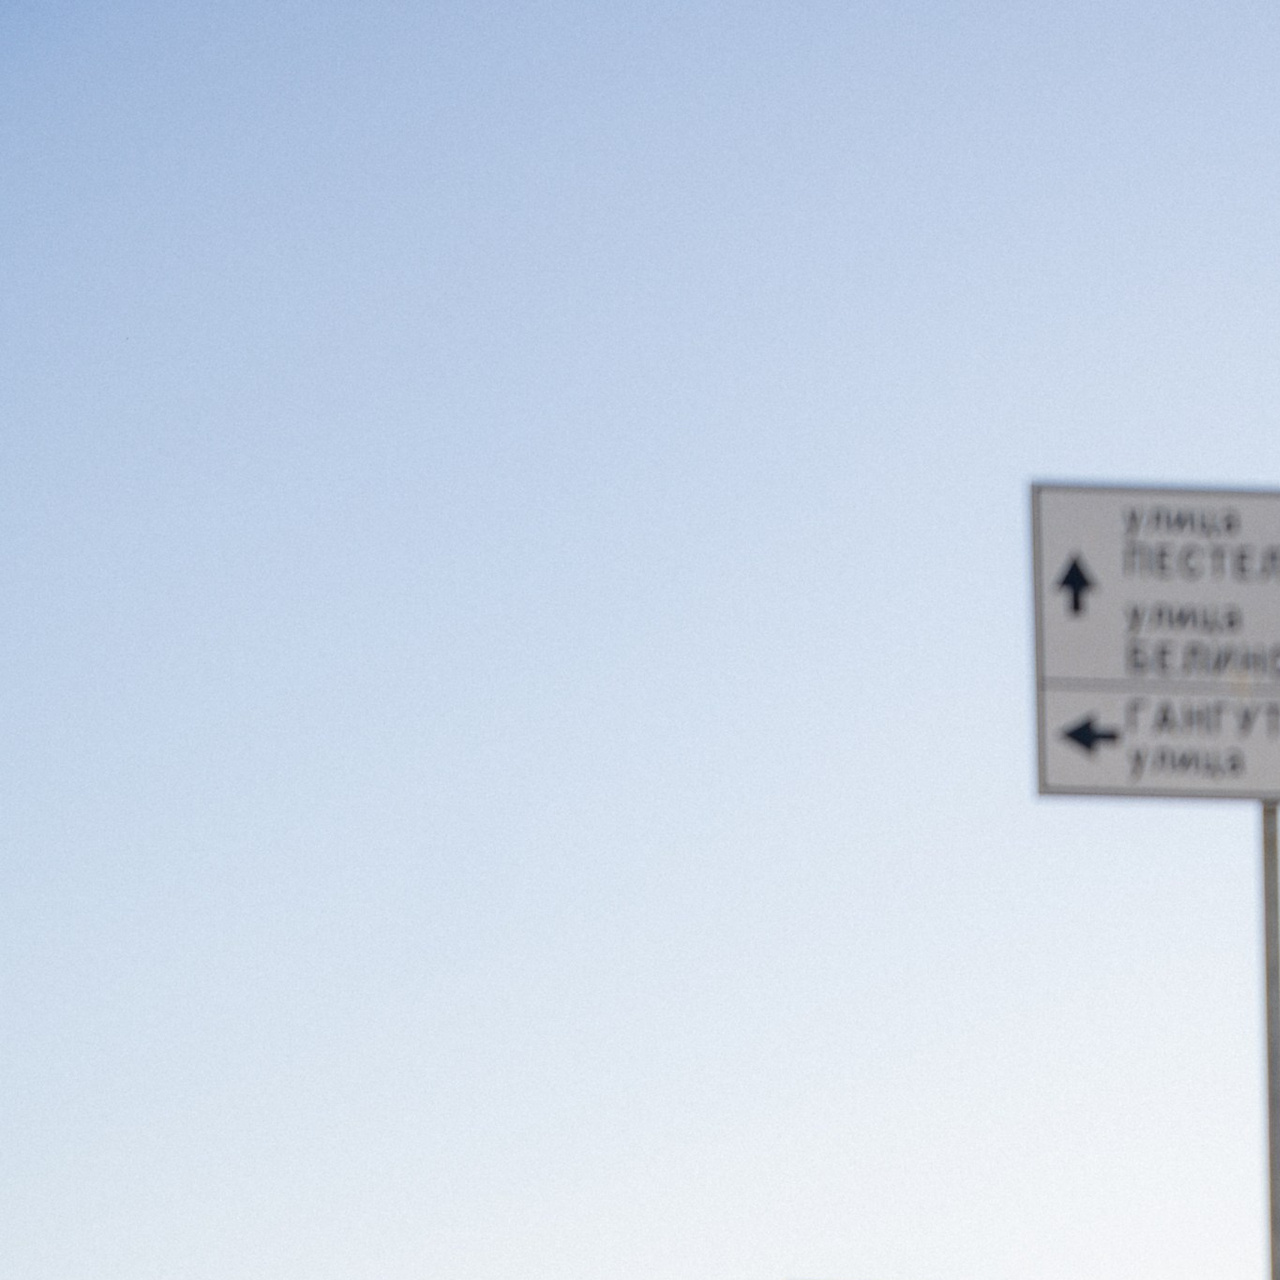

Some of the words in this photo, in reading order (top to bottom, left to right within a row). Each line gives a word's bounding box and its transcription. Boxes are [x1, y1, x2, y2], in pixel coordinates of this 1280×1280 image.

[1122, 504, 1242, 541] улица
[1125, 602, 1243, 639] улица
[1127, 747, 1246, 782] улица
